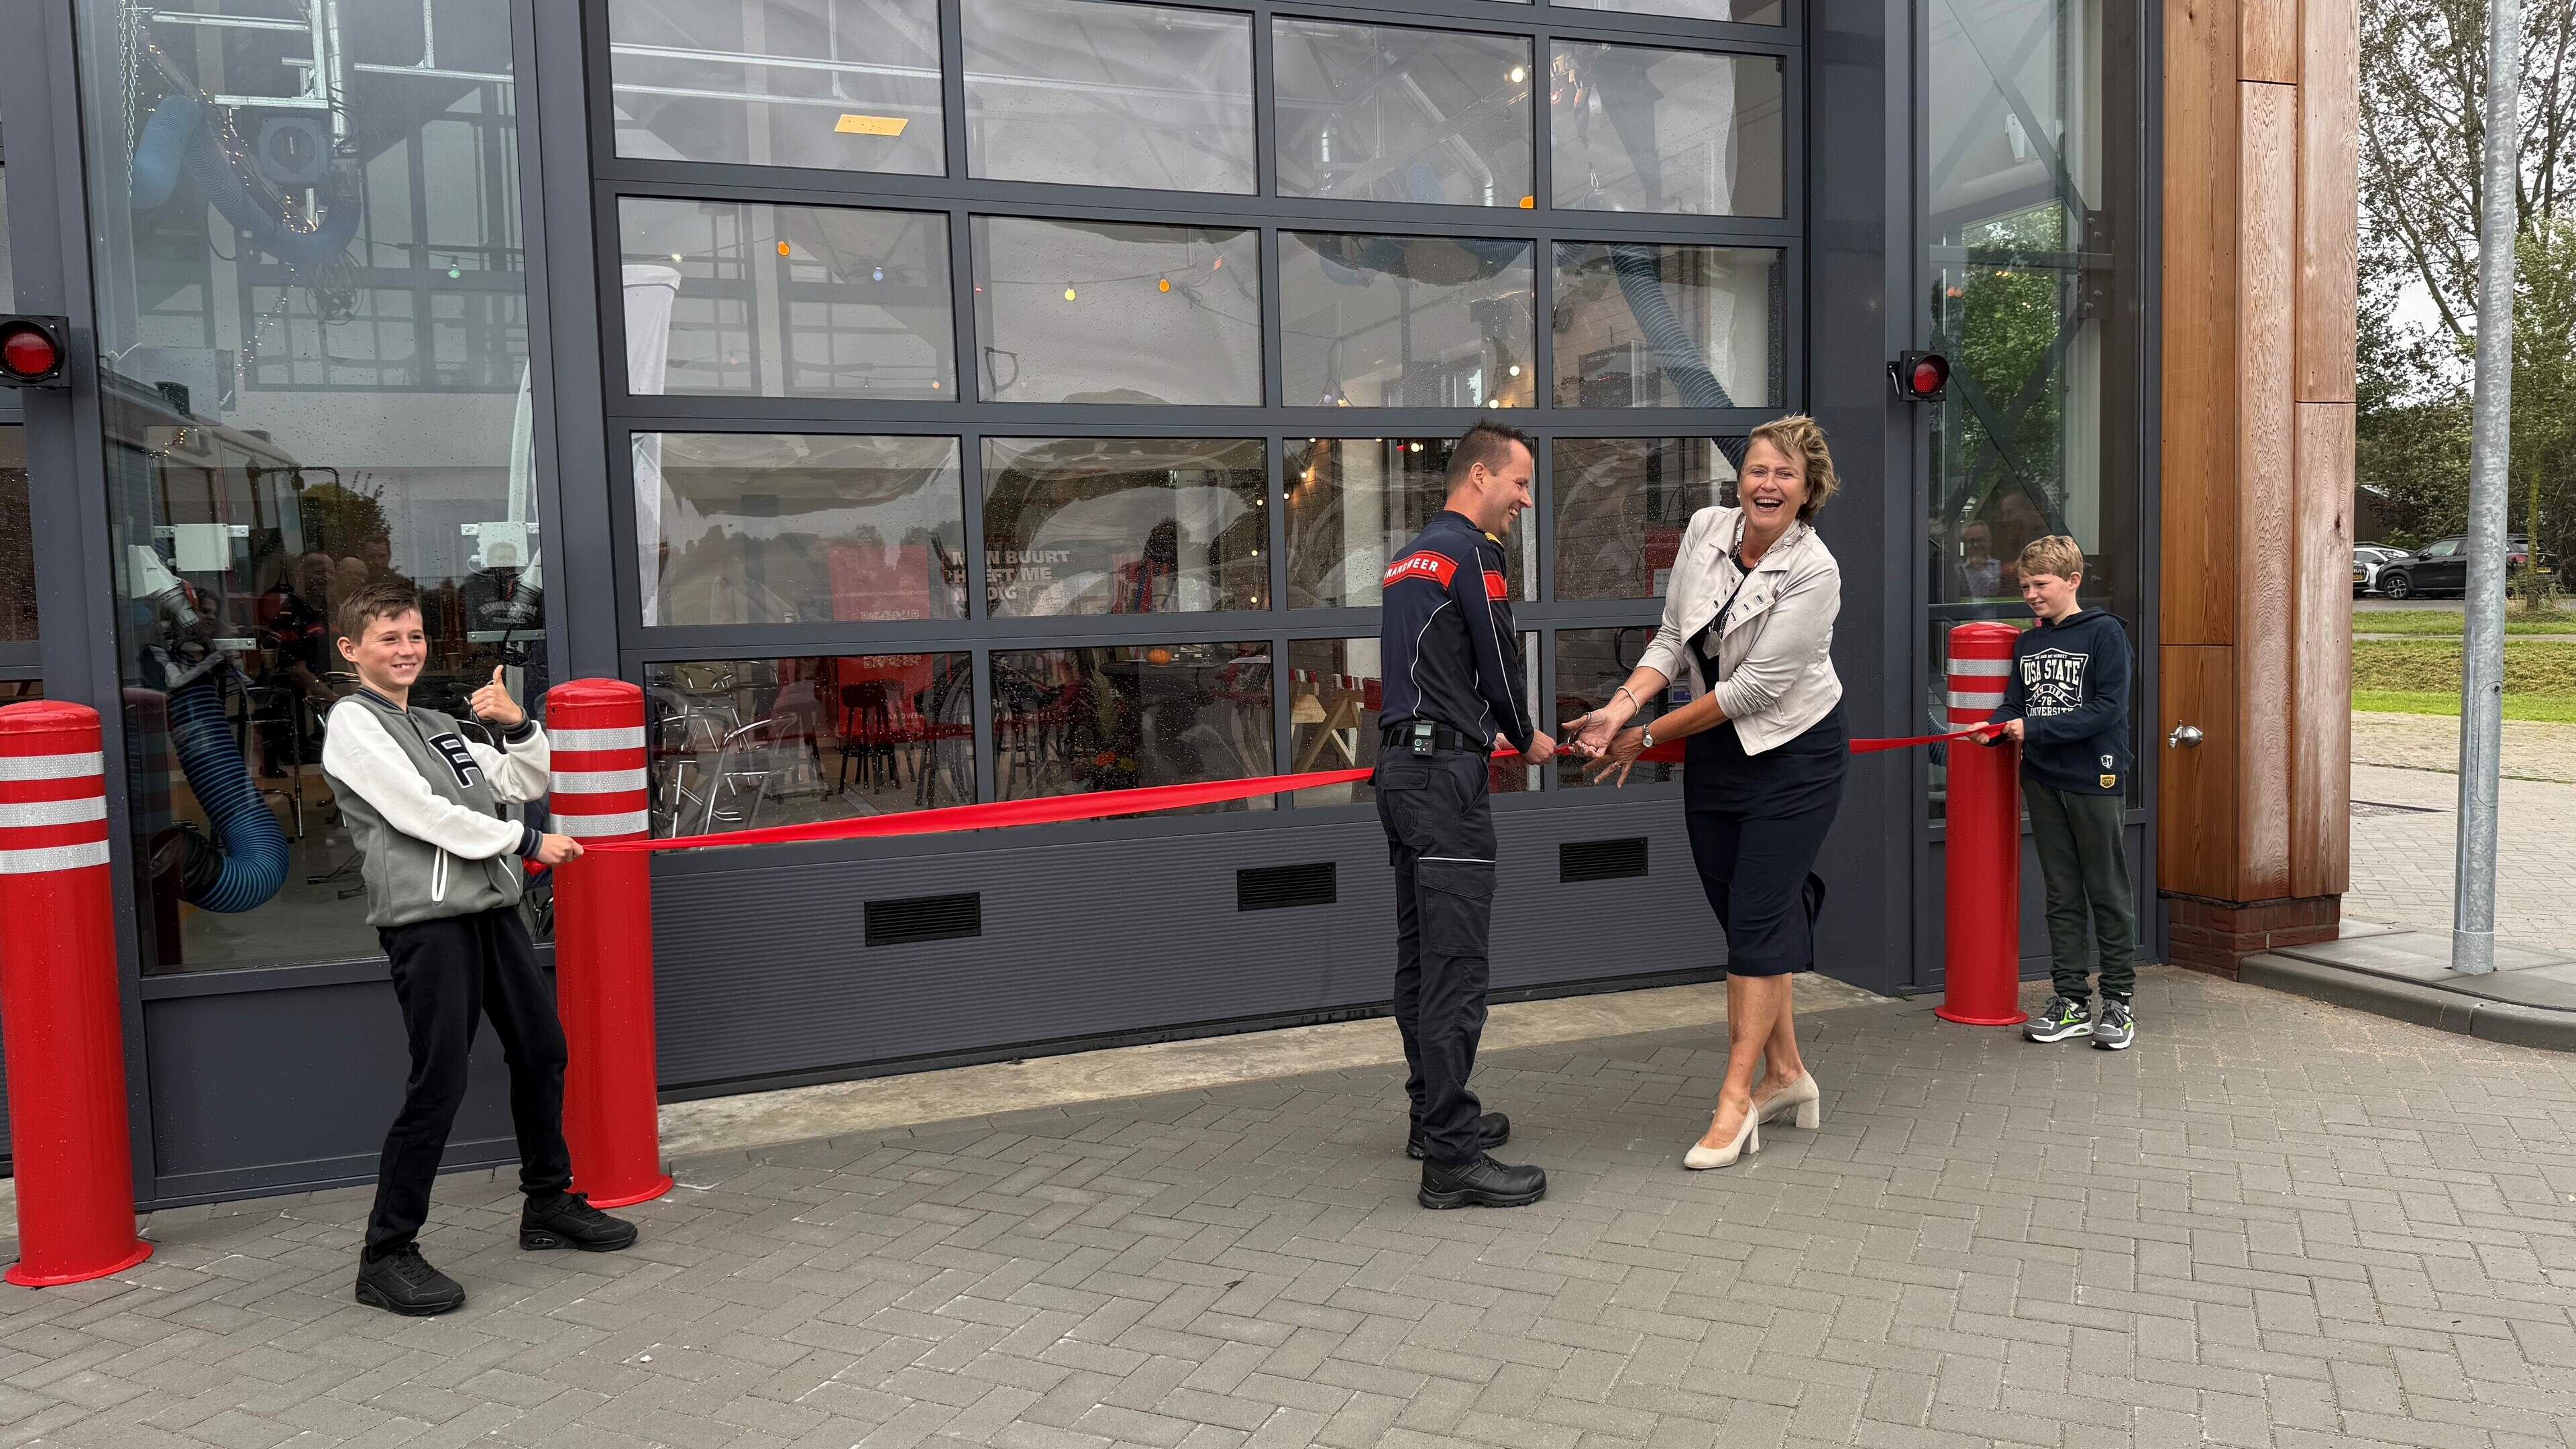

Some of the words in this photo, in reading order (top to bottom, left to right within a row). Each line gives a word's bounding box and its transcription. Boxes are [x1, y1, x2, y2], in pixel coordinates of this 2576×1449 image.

[952, 550, 1001, 566] MN
[1006, 549, 1071, 564] BUURT
[954, 568, 1015, 584] HEFT
[1020, 566, 1053, 581] ME
[1384, 557, 1439, 580] RANDWEER
[953, 586, 1018, 602] NDIG
[2024, 660, 2041, 686] USA
[2044, 659, 2080, 686] STATE
[2049, 685, 2066, 700] YORK
